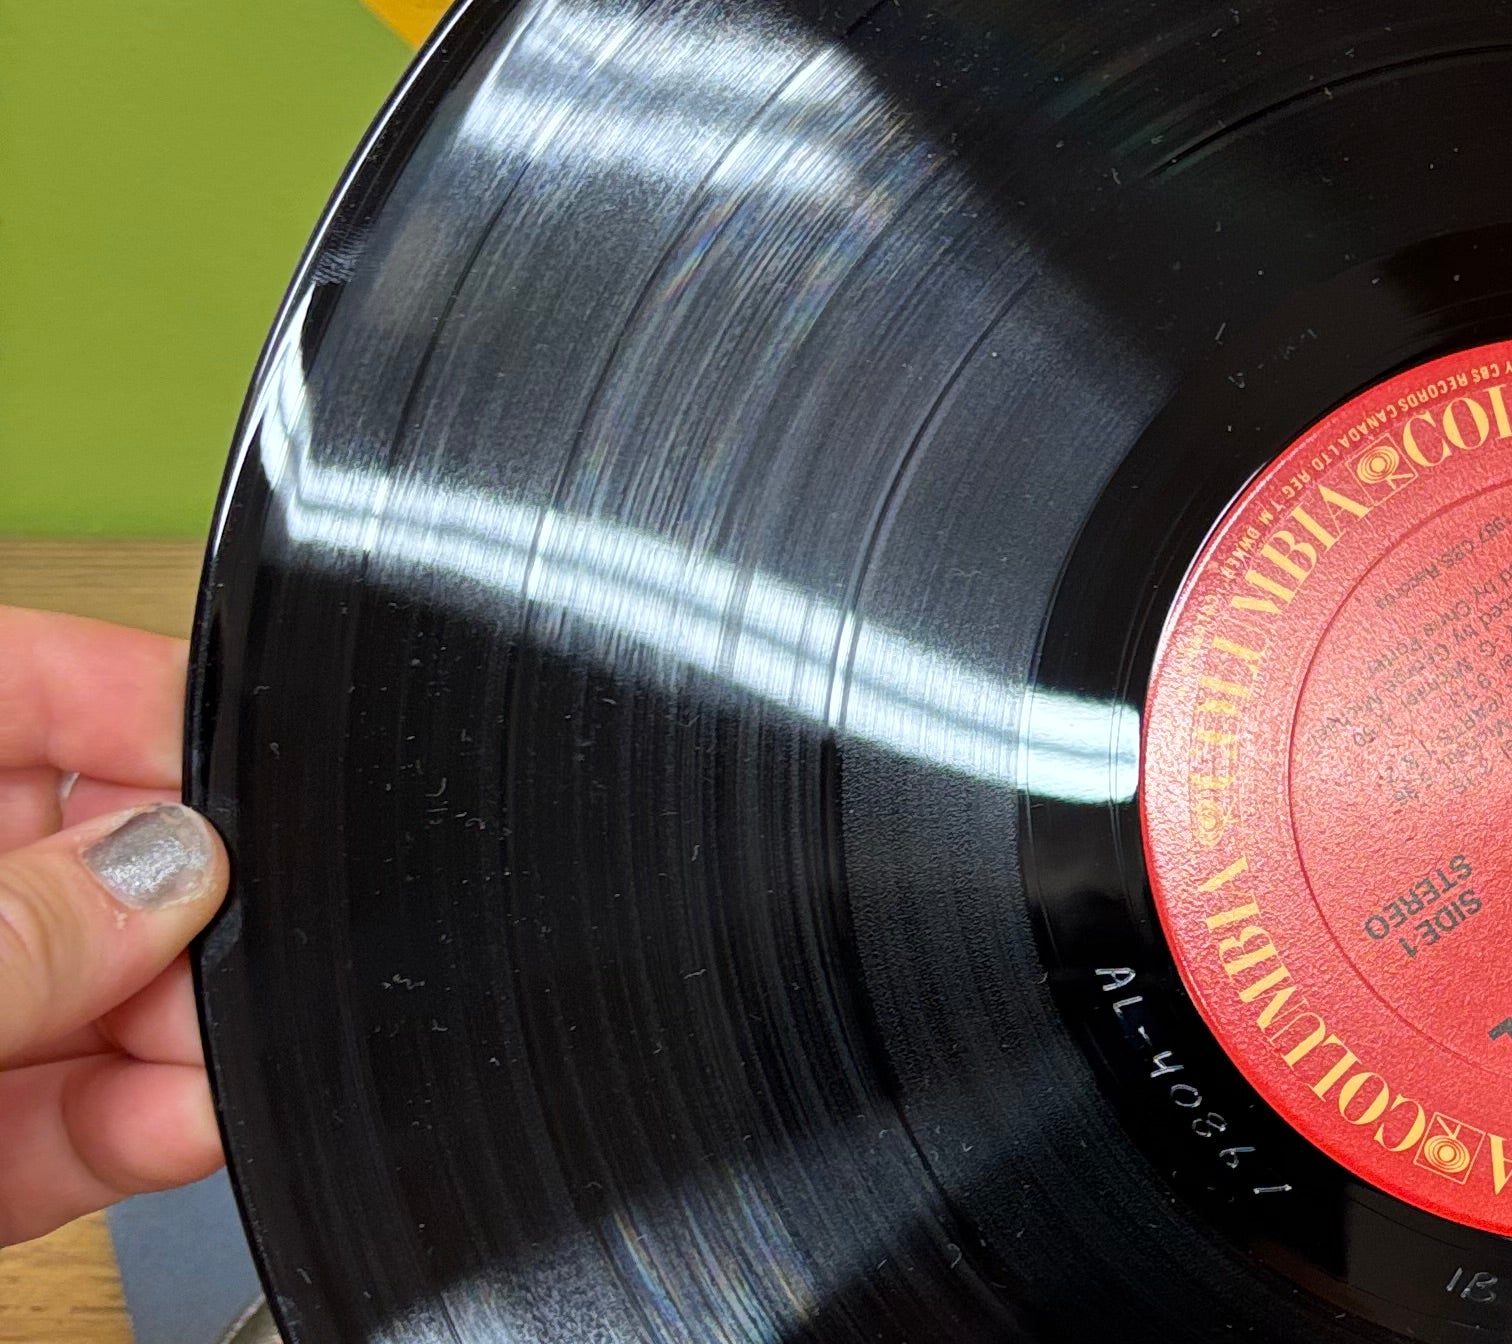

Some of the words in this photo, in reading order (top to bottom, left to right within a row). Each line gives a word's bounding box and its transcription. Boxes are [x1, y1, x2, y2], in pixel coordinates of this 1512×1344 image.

[1397, 372, 1469, 414] RECORDS
[1470, 363, 1501, 386] CBS
[1336, 403, 1400, 451] CANADA
[1359, 851, 1476, 945] STEREO
[1413, 886, 1485, 947] SIDE
[1198, 855, 1426, 1152] COLUMBIA
